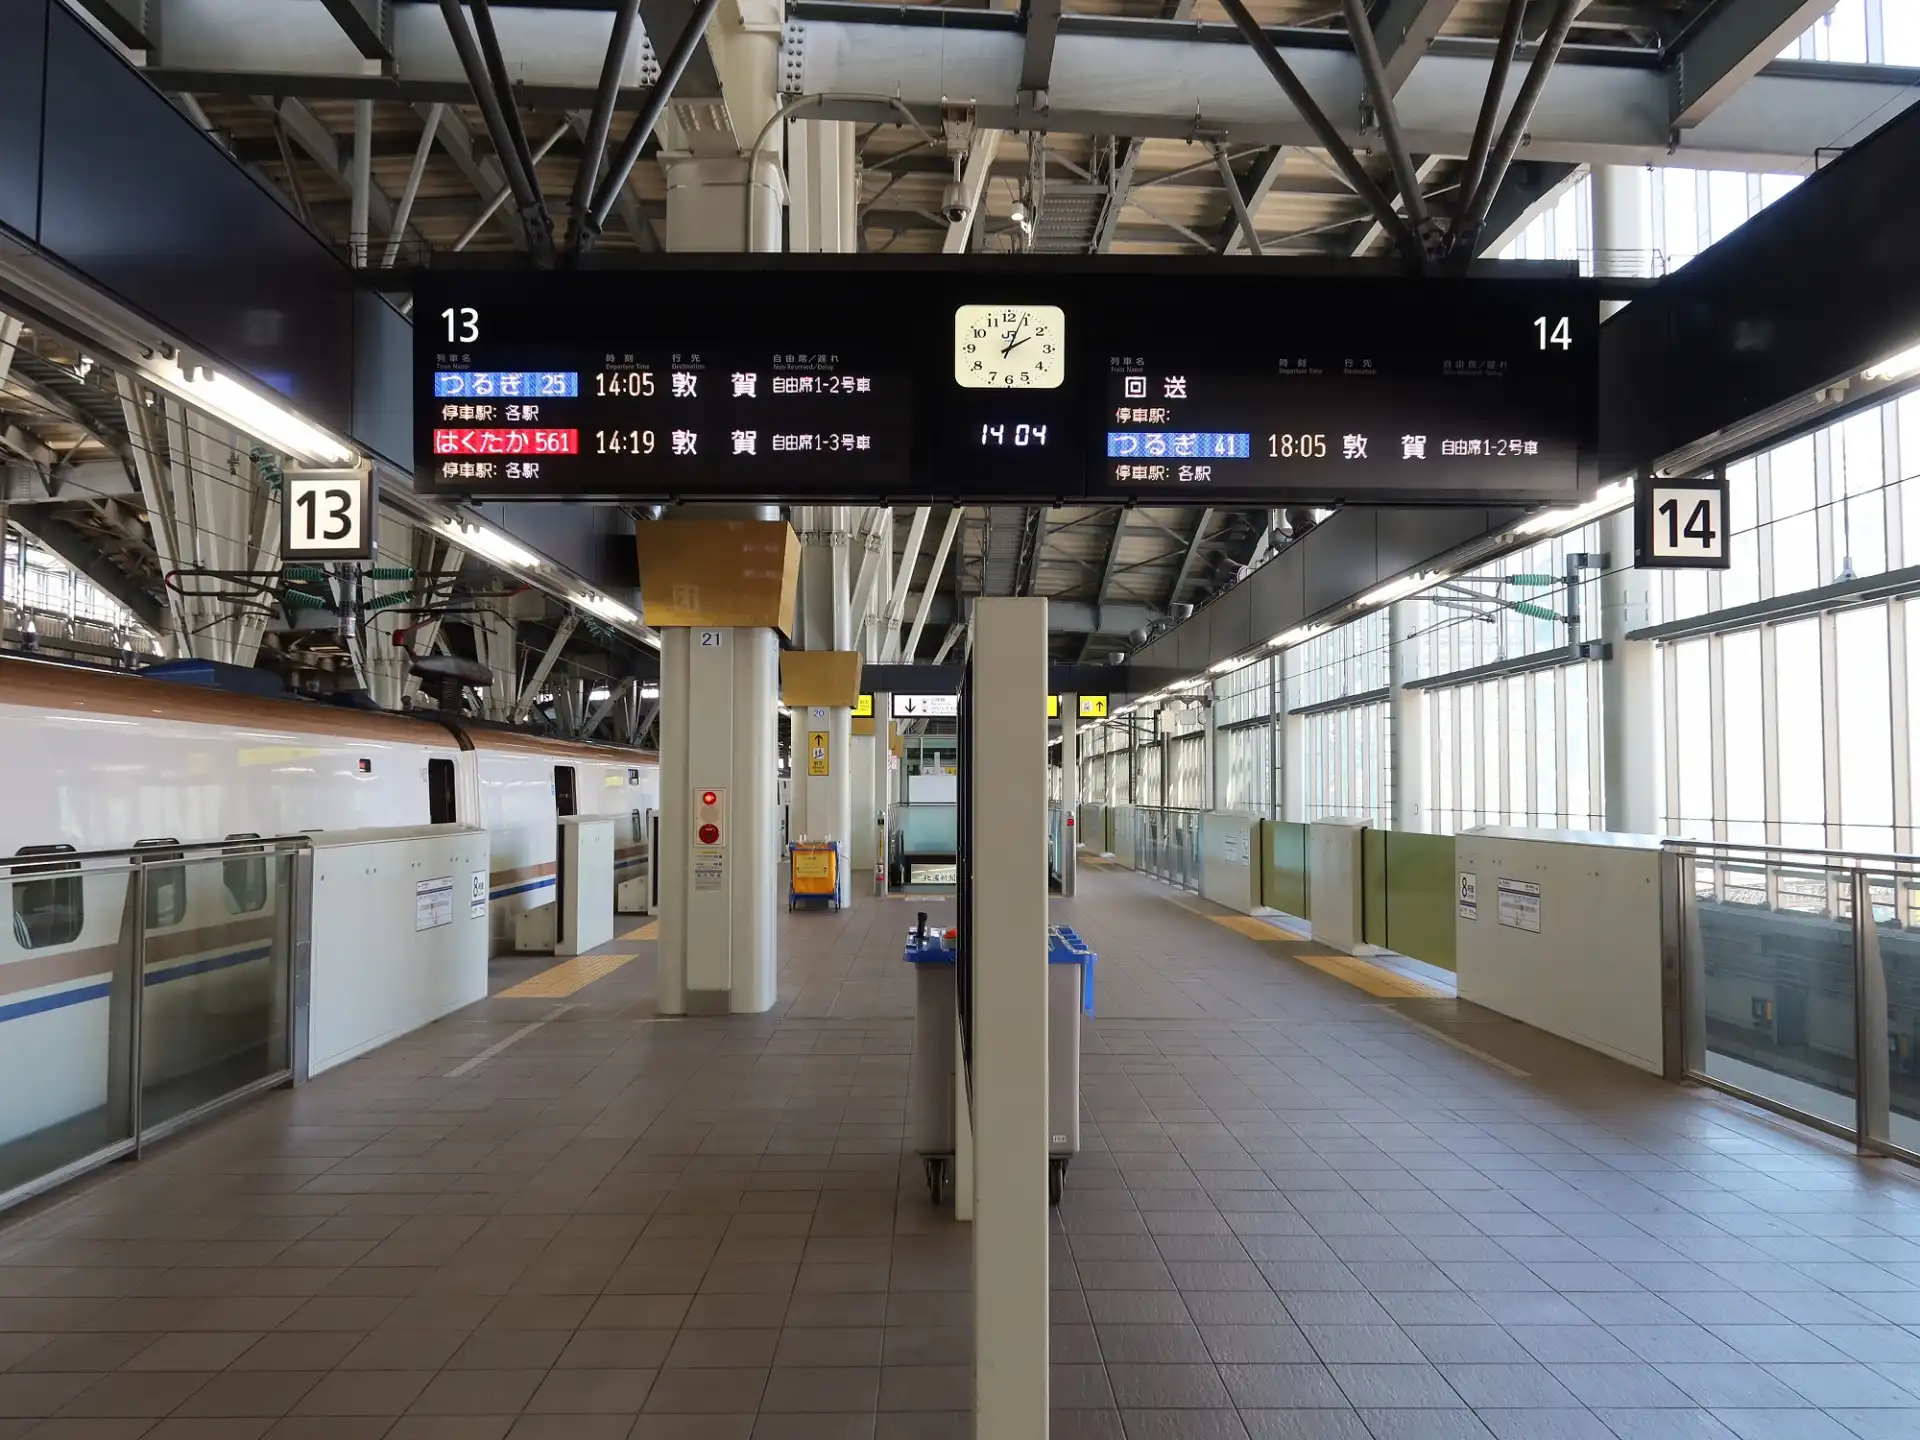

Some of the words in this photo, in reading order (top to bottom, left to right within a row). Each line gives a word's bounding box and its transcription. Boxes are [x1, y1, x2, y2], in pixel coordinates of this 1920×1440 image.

[441, 307, 479, 343] 13
[988, 318, 999, 328] 11
[1002, 313, 1016, 323] 12
[973, 329, 987, 339] 10
[1035, 327, 1045, 337] 2
[1533, 316, 1573, 351] 14
[966, 344, 976, 353] 9
[1042, 344, 1052, 354] 3
[436, 353, 471, 363] 列車名
[605, 353, 634, 363] 時刻
[672, 353, 700, 363] 行先
[973, 361, 983, 371] 8
[1034, 361, 1045, 371] 4
[1110, 357, 1145, 366] 列車名
[440, 373, 524, 396] つるぎ
[541, 375, 566, 395] 25
[595, 372, 656, 397] 14:05
[772, 375, 872, 394] 自由席1-2号車
[988, 371, 998, 381] 7
[1004, 375, 1014, 385] 6
[1020, 371, 1030, 382] 5
[1124, 375, 1188, 399] 回送
[505, 404, 540, 421] 各駅
[436, 431, 529, 454] はくたか
[535, 432, 570, 452] 561
[595, 430, 656, 455] 14:19
[772, 433, 872, 451] 自由席1-3号車
[1113, 433, 1197, 456] つるぎ
[1214, 435, 1236, 455] 41
[1268, 433, 1327, 458] 18:05
[1441, 439, 1539, 457] 自由席1-2号車
[505, 462, 541, 479] 各駅
[1178, 465, 1212, 482] 各駅
[296, 489, 352, 541] 13
[1658, 498, 1717, 549] 14
[702, 632, 721, 646] 21
[813, 708, 825, 718] 20
[473, 876, 479, 898] 8
[1461, 876, 1468, 898] 8
